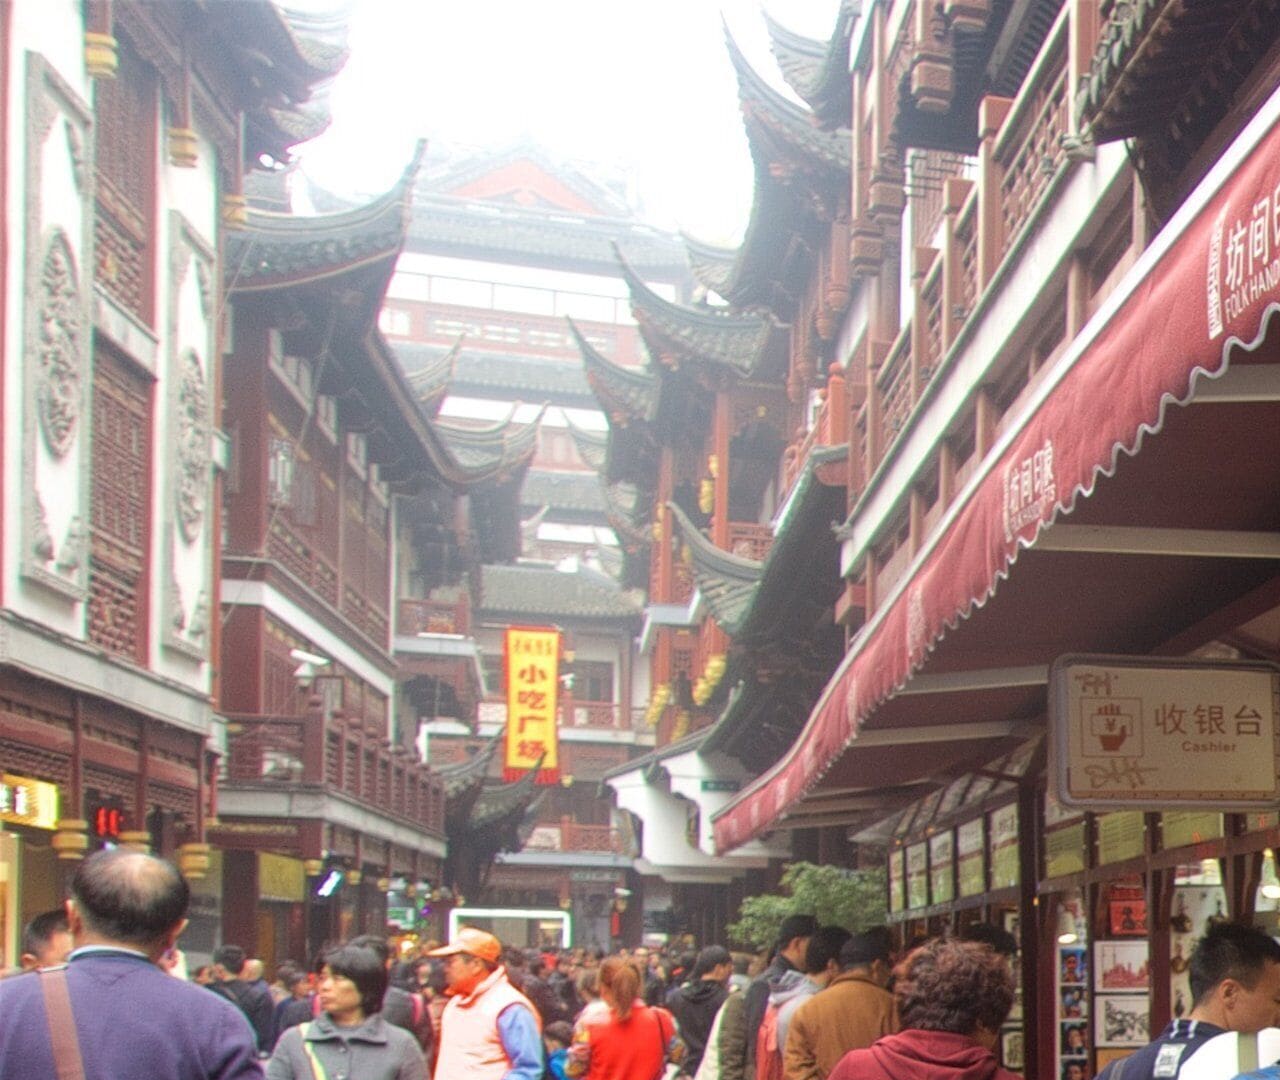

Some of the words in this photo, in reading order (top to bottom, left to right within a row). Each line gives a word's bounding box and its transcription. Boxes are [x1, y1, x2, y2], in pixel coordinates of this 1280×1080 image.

[1224, 278, 1250, 324] FOLK
[517, 664, 548, 759] 小吃广场
[1155, 703, 1262, 736] 收银台
[1182, 741, 1237, 754] Cashier
